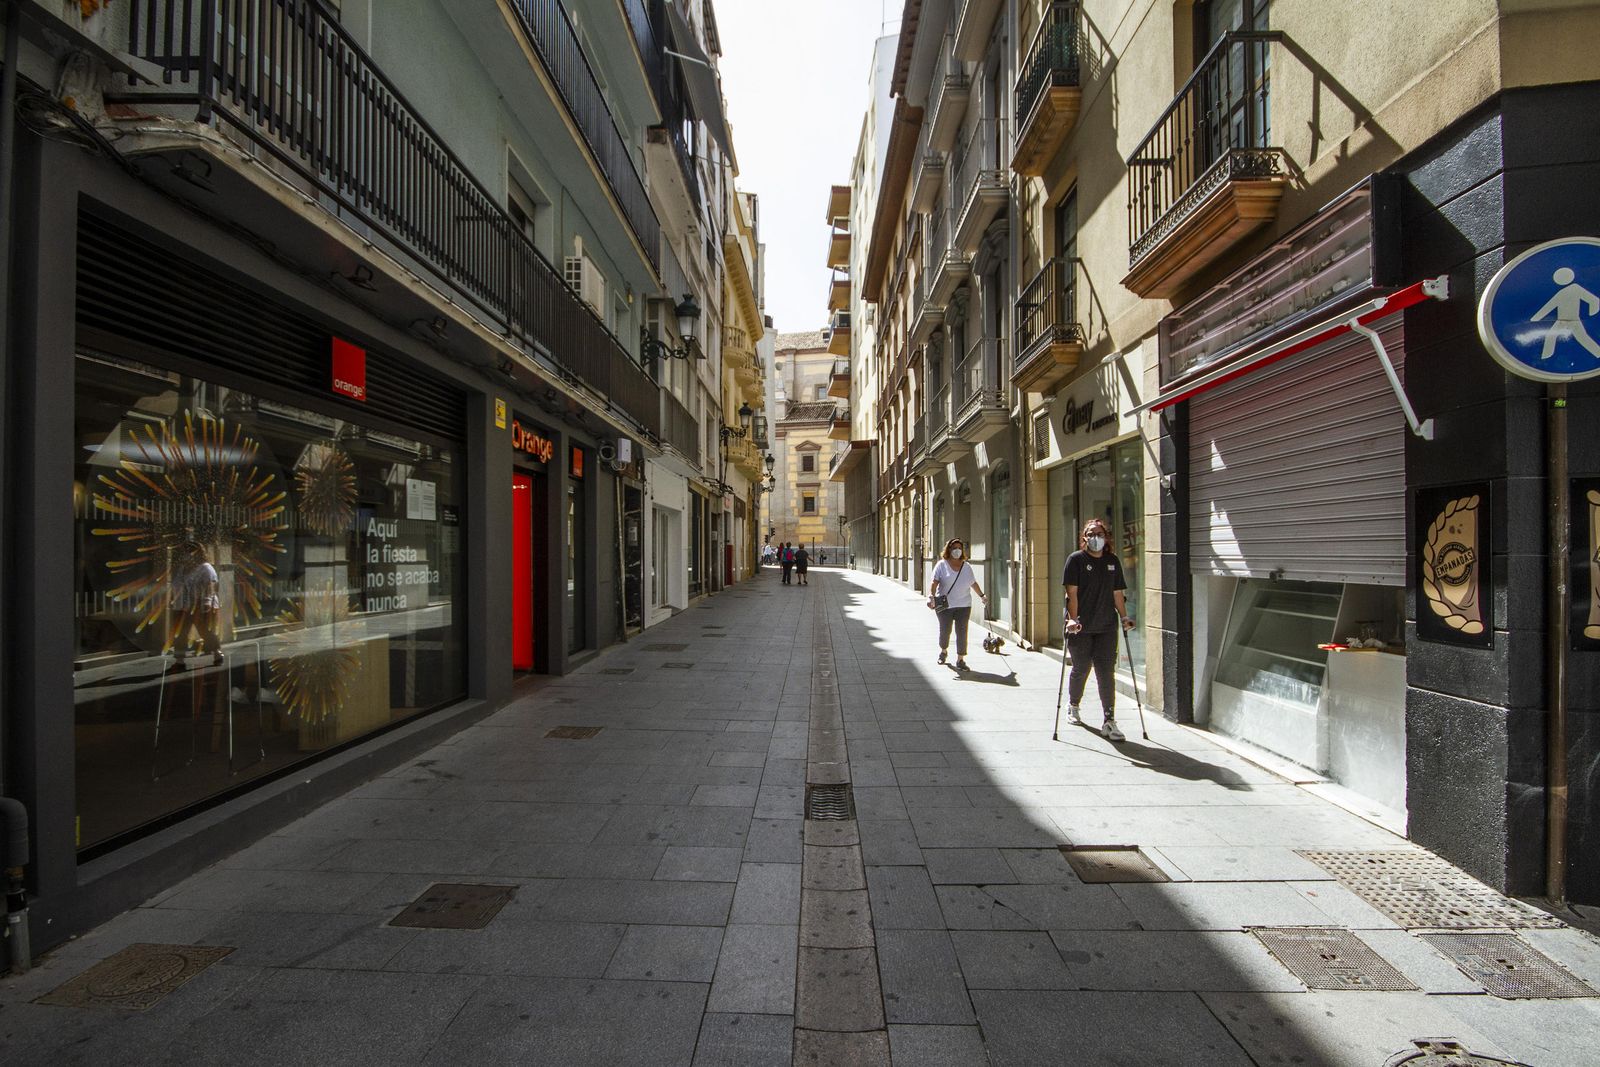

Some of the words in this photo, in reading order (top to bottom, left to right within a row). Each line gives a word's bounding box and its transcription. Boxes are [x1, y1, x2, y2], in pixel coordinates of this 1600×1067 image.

[334, 378, 363, 397] orange
[512, 419, 553, 463] Orange
[366, 517, 399, 542] Aquí
[366, 543, 379, 563] la
[383, 544, 417, 563] fiesta
[1436, 551, 1473, 577] EMPANADAS
[366, 572, 384, 588] no
[387, 571, 402, 586] se
[405, 565, 439, 585] acaba
[366, 594, 407, 613] nunca
